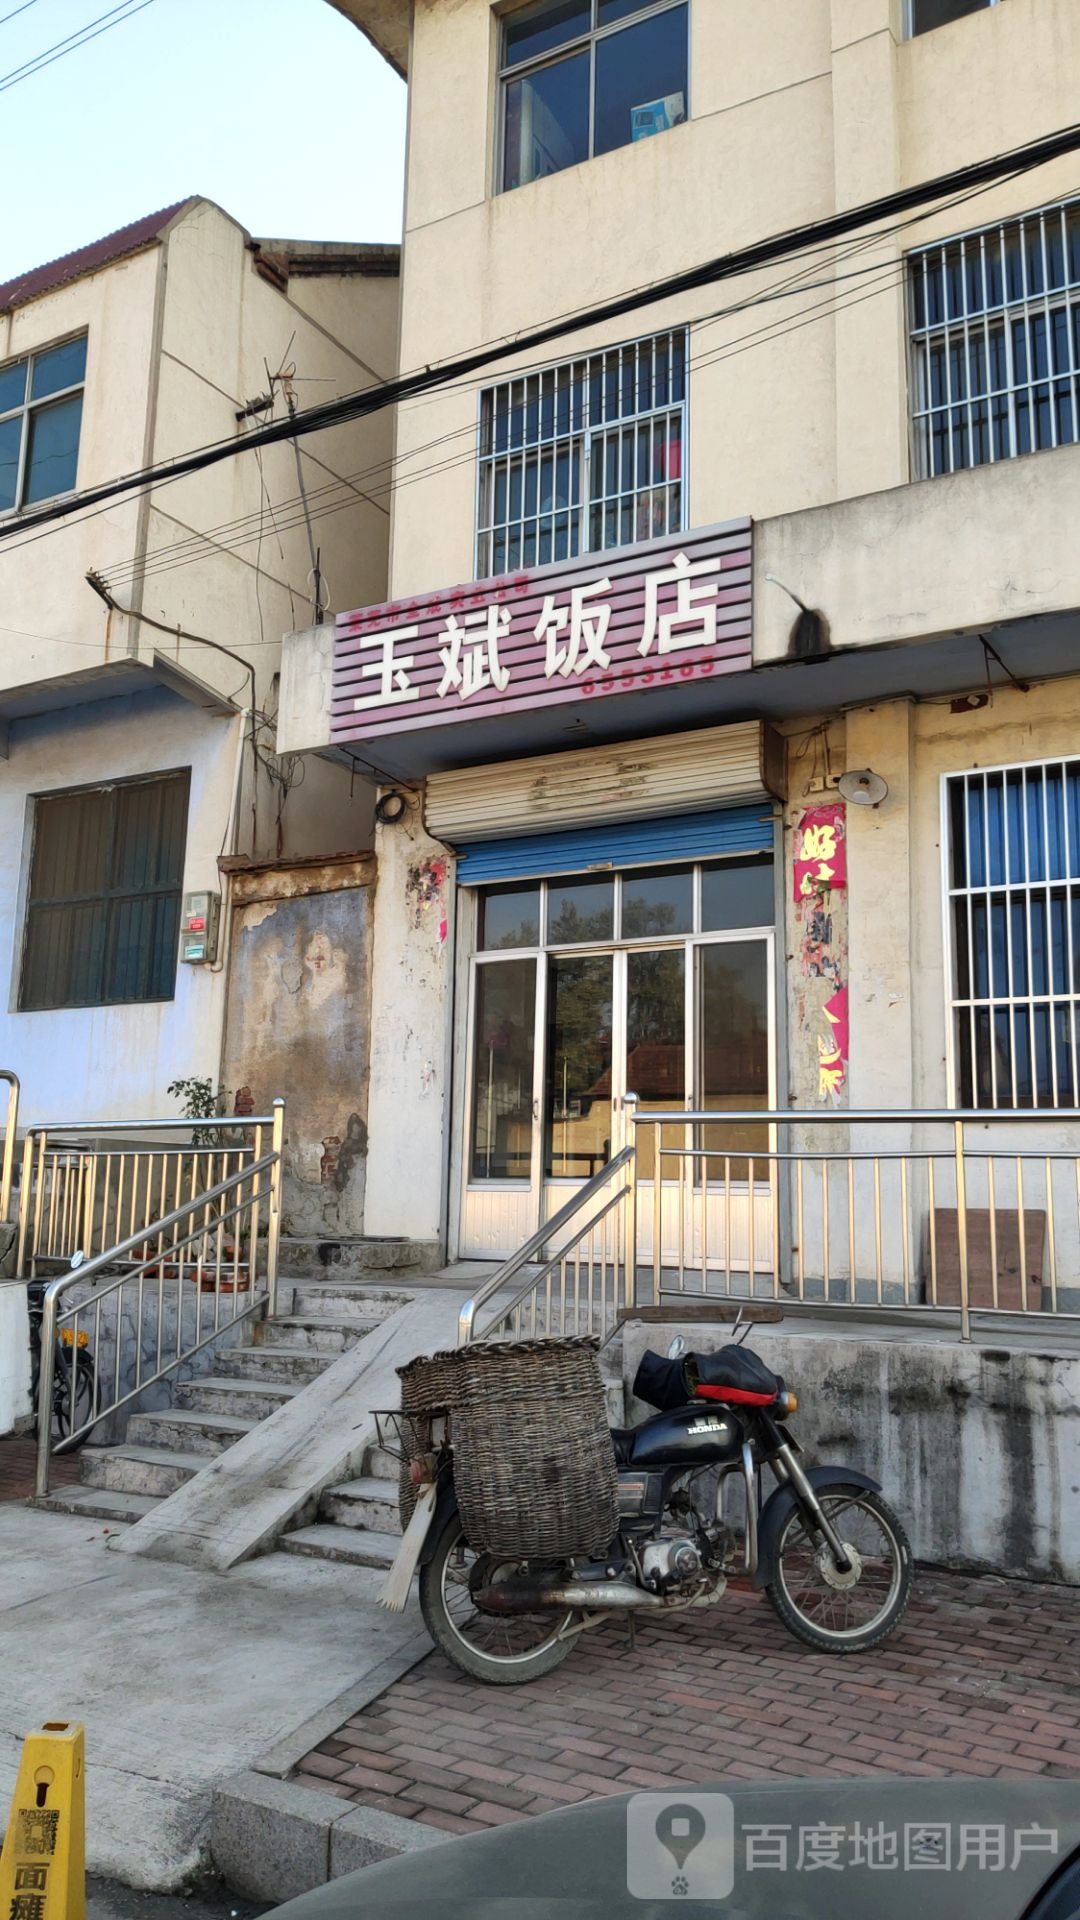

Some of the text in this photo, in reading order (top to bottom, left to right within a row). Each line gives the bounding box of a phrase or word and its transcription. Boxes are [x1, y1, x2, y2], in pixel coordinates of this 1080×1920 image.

[354, 552, 721, 710] 玉斌饭店
[687, 1423, 728, 1434] HONDA
